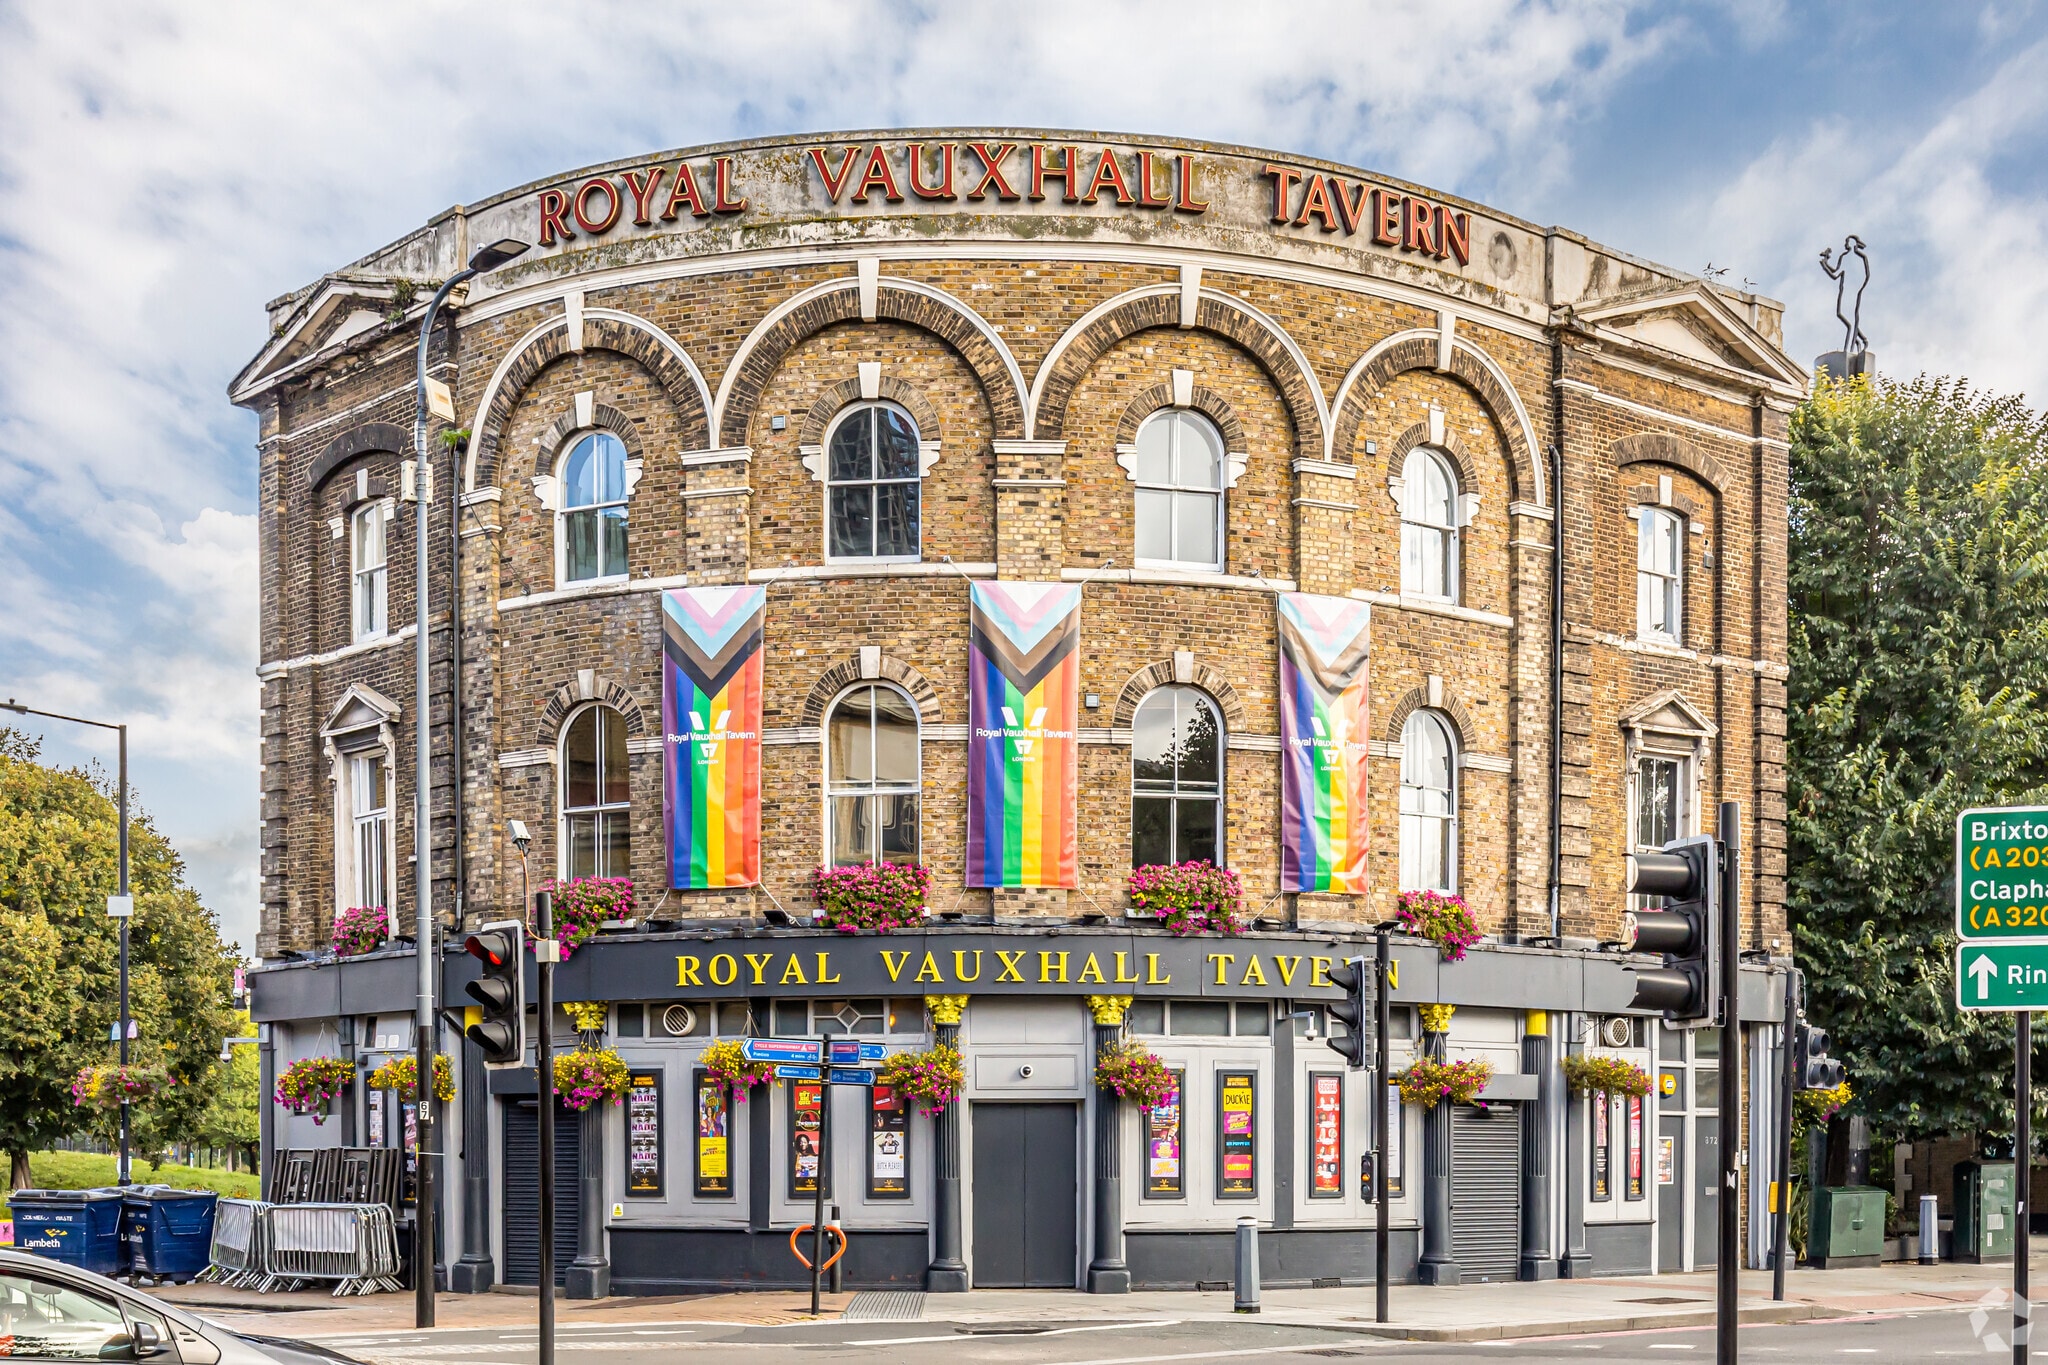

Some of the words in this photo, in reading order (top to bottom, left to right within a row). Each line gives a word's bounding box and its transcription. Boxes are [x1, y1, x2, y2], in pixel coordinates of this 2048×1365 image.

[537, 156, 749, 248] ROYAL
[807, 141, 1210, 214] VAUXHALL
[1262, 163, 1472, 266] TAVERN
[667, 732, 689, 744] Royal
[690, 731, 726, 741] Vauxhall
[726, 730, 756, 740] Tavern
[976, 728, 1002, 739] Royal
[1003, 728, 1042, 738] Vauxhall
[1043, 729, 1073, 739] Tavern
[1289, 736, 1312, 748] Royal
[1346, 740, 1367, 750] Tavern
[1970, 878, 2048, 903] Claph
[675, 952, 841, 987] ROYAL
[879, 950, 1172, 985] VAUXHALL
[1225, 1094, 1250, 1104] DUCKIE
[24, 1238, 60, 1248] Lambeth
